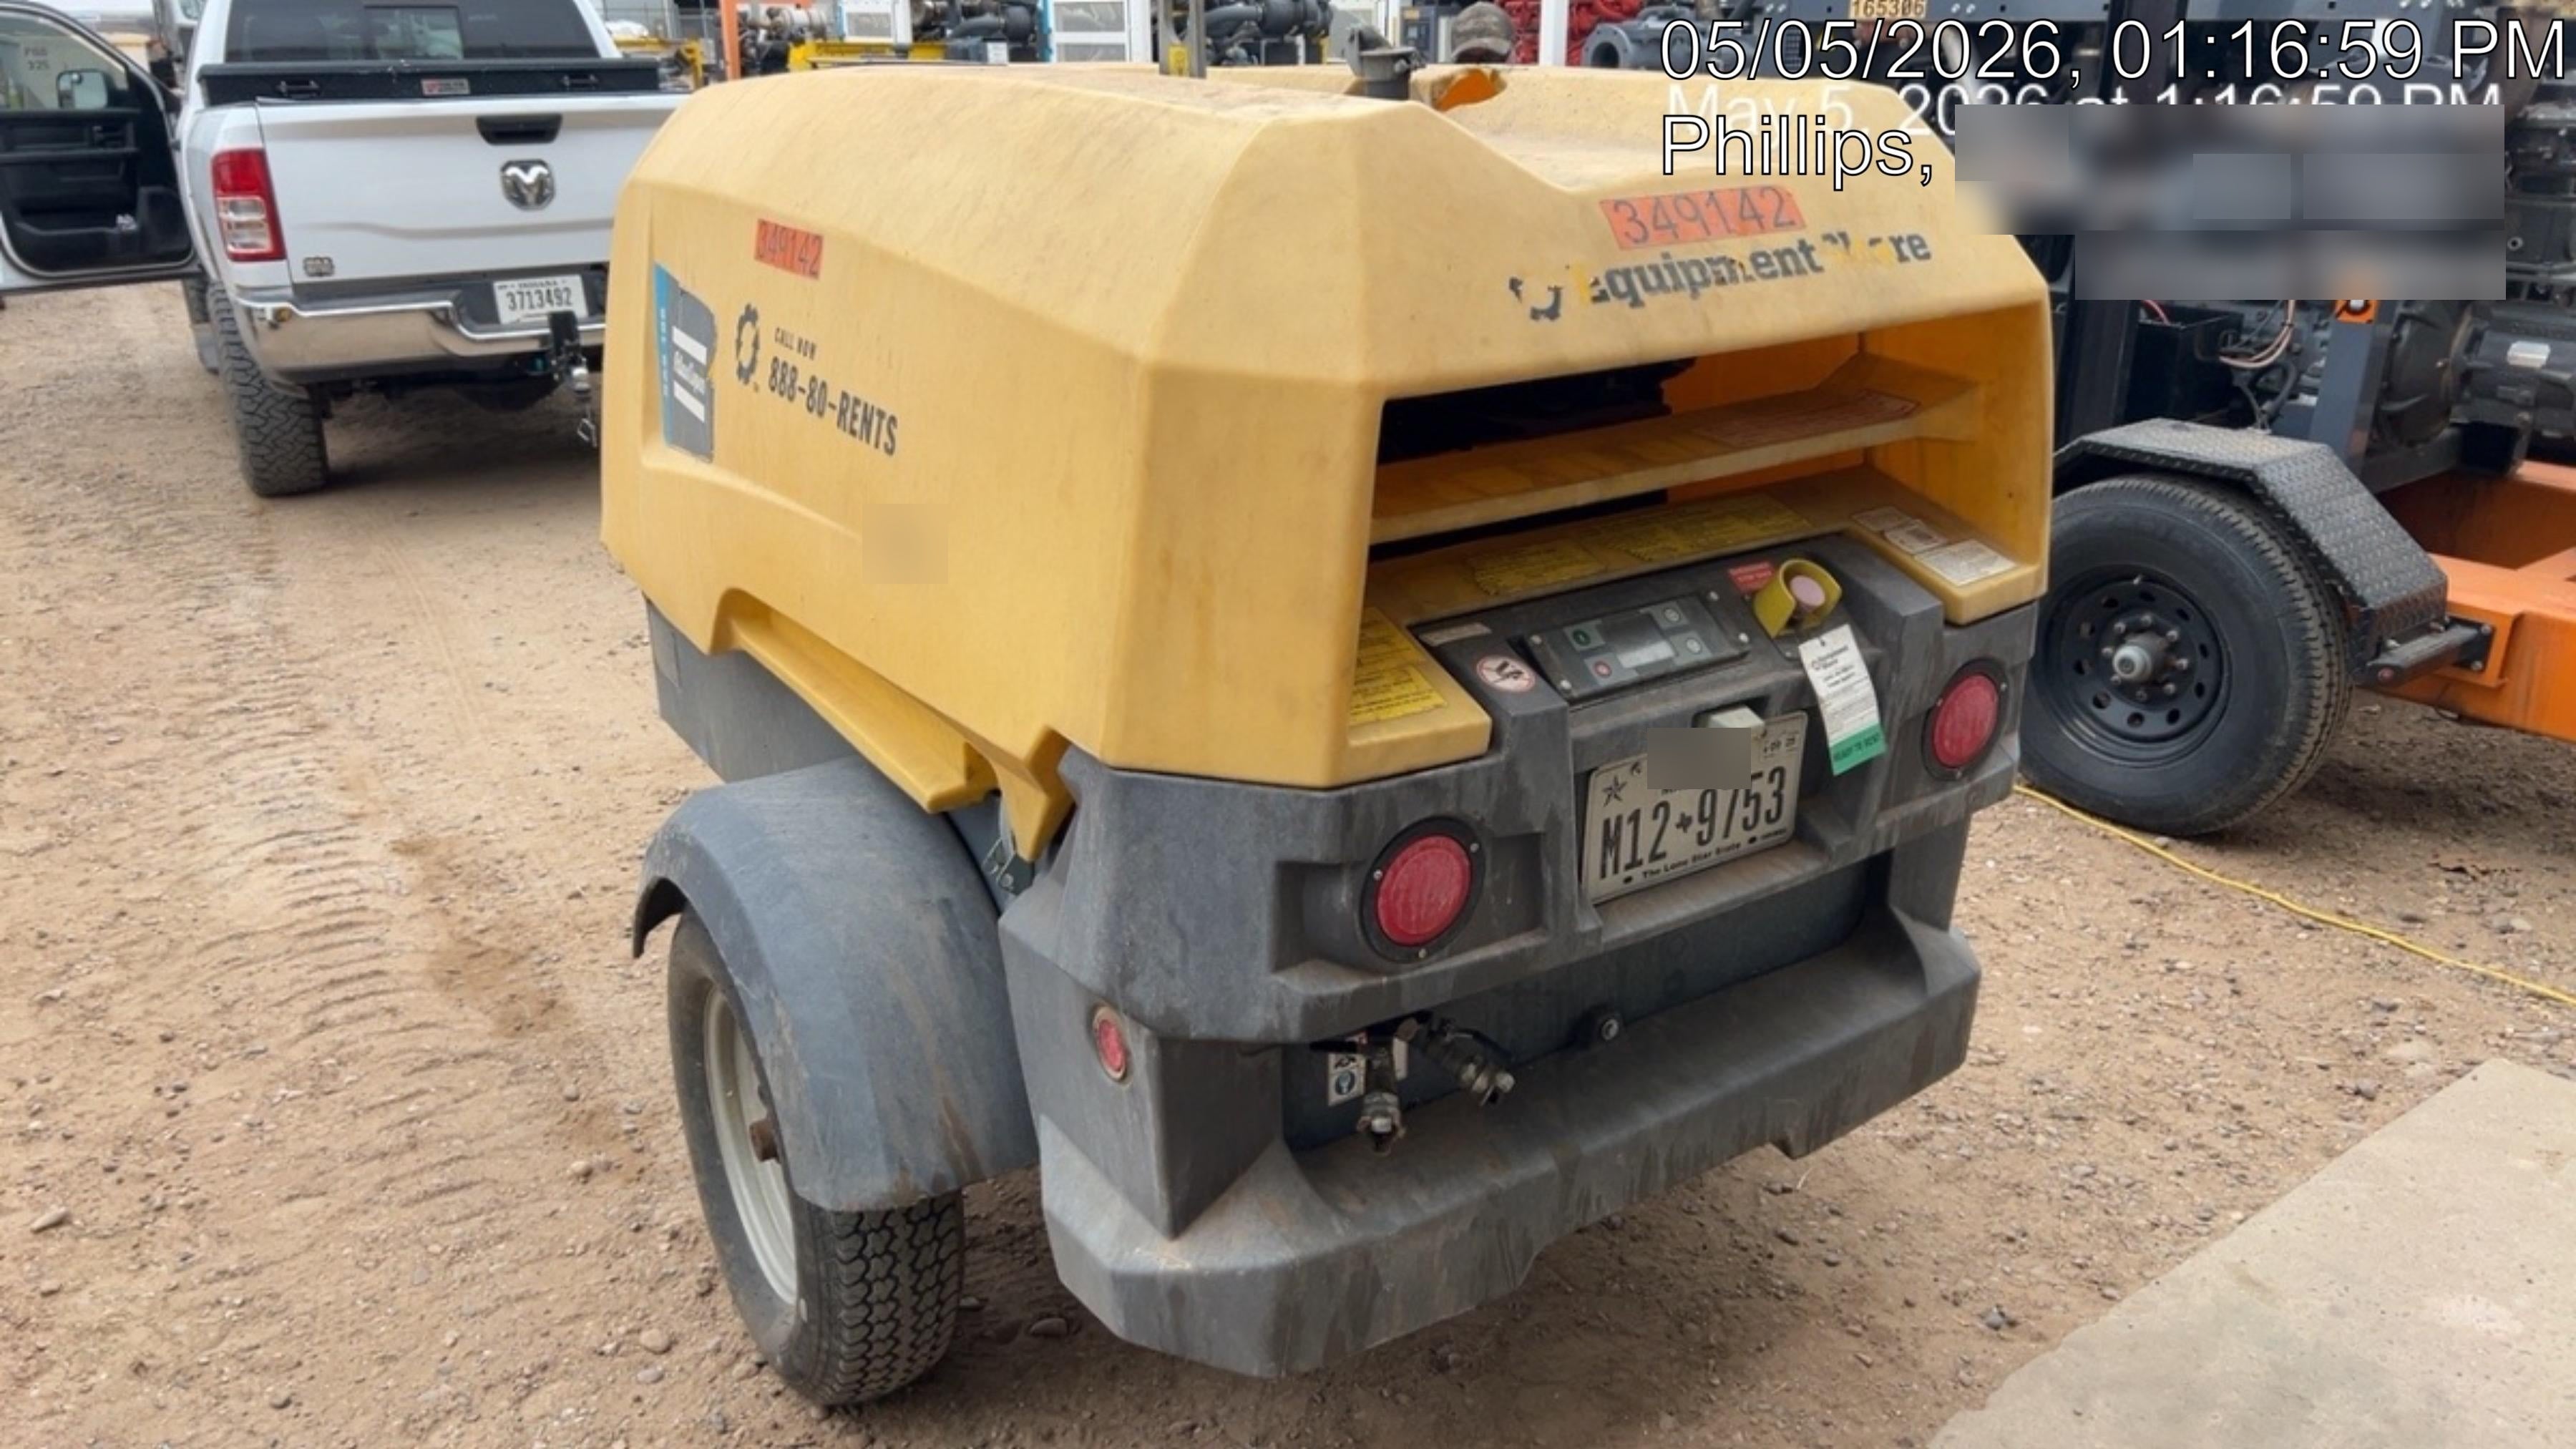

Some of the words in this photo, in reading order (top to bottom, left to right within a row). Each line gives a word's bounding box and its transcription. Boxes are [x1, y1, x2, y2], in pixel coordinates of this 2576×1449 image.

[1853, 0, 1924, 17] 165306
[1614, 185, 1795, 244] 349142
[768, 356, 898, 457] 888-80-RENTS
